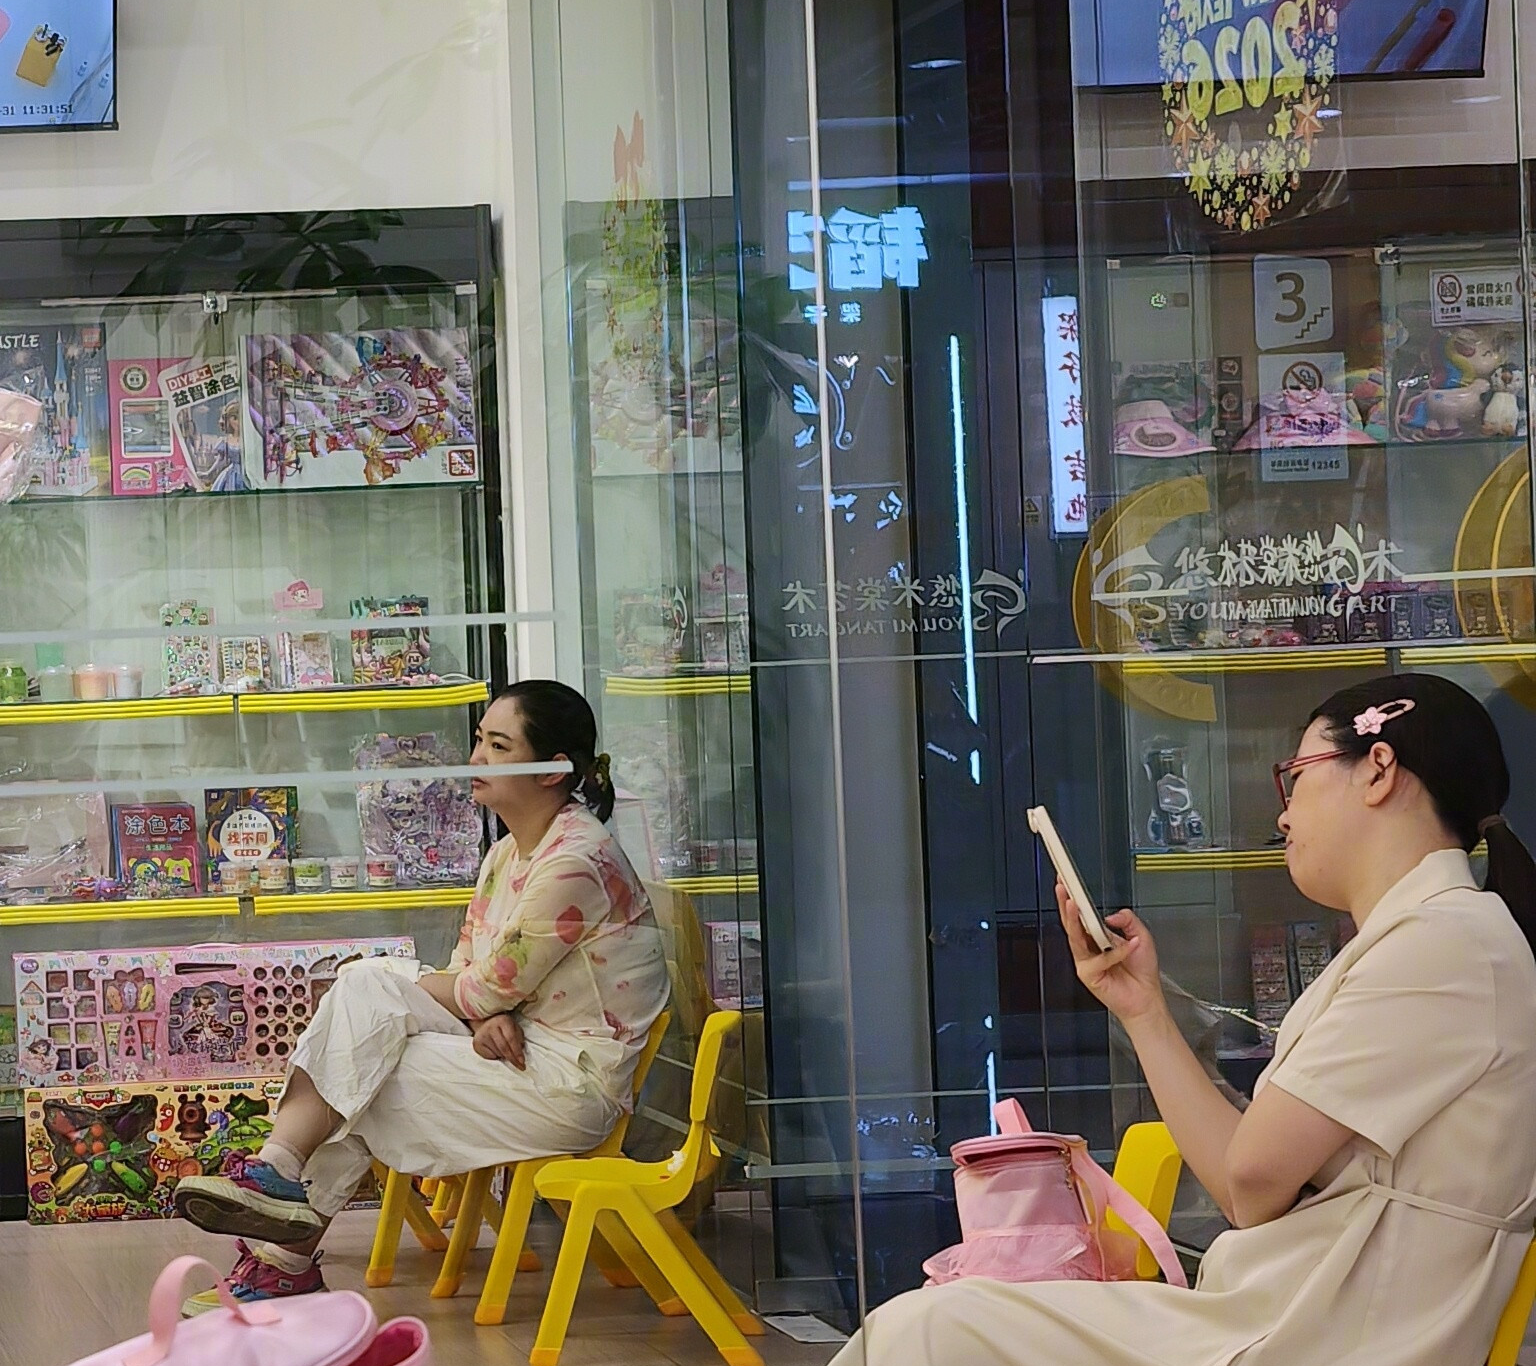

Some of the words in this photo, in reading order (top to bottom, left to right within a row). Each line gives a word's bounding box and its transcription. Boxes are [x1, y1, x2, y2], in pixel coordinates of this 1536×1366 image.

[1275, 272, 1307, 323] 3
[125, 814, 191, 836] 涂色本
[227, 831, 268, 845] 找不同
